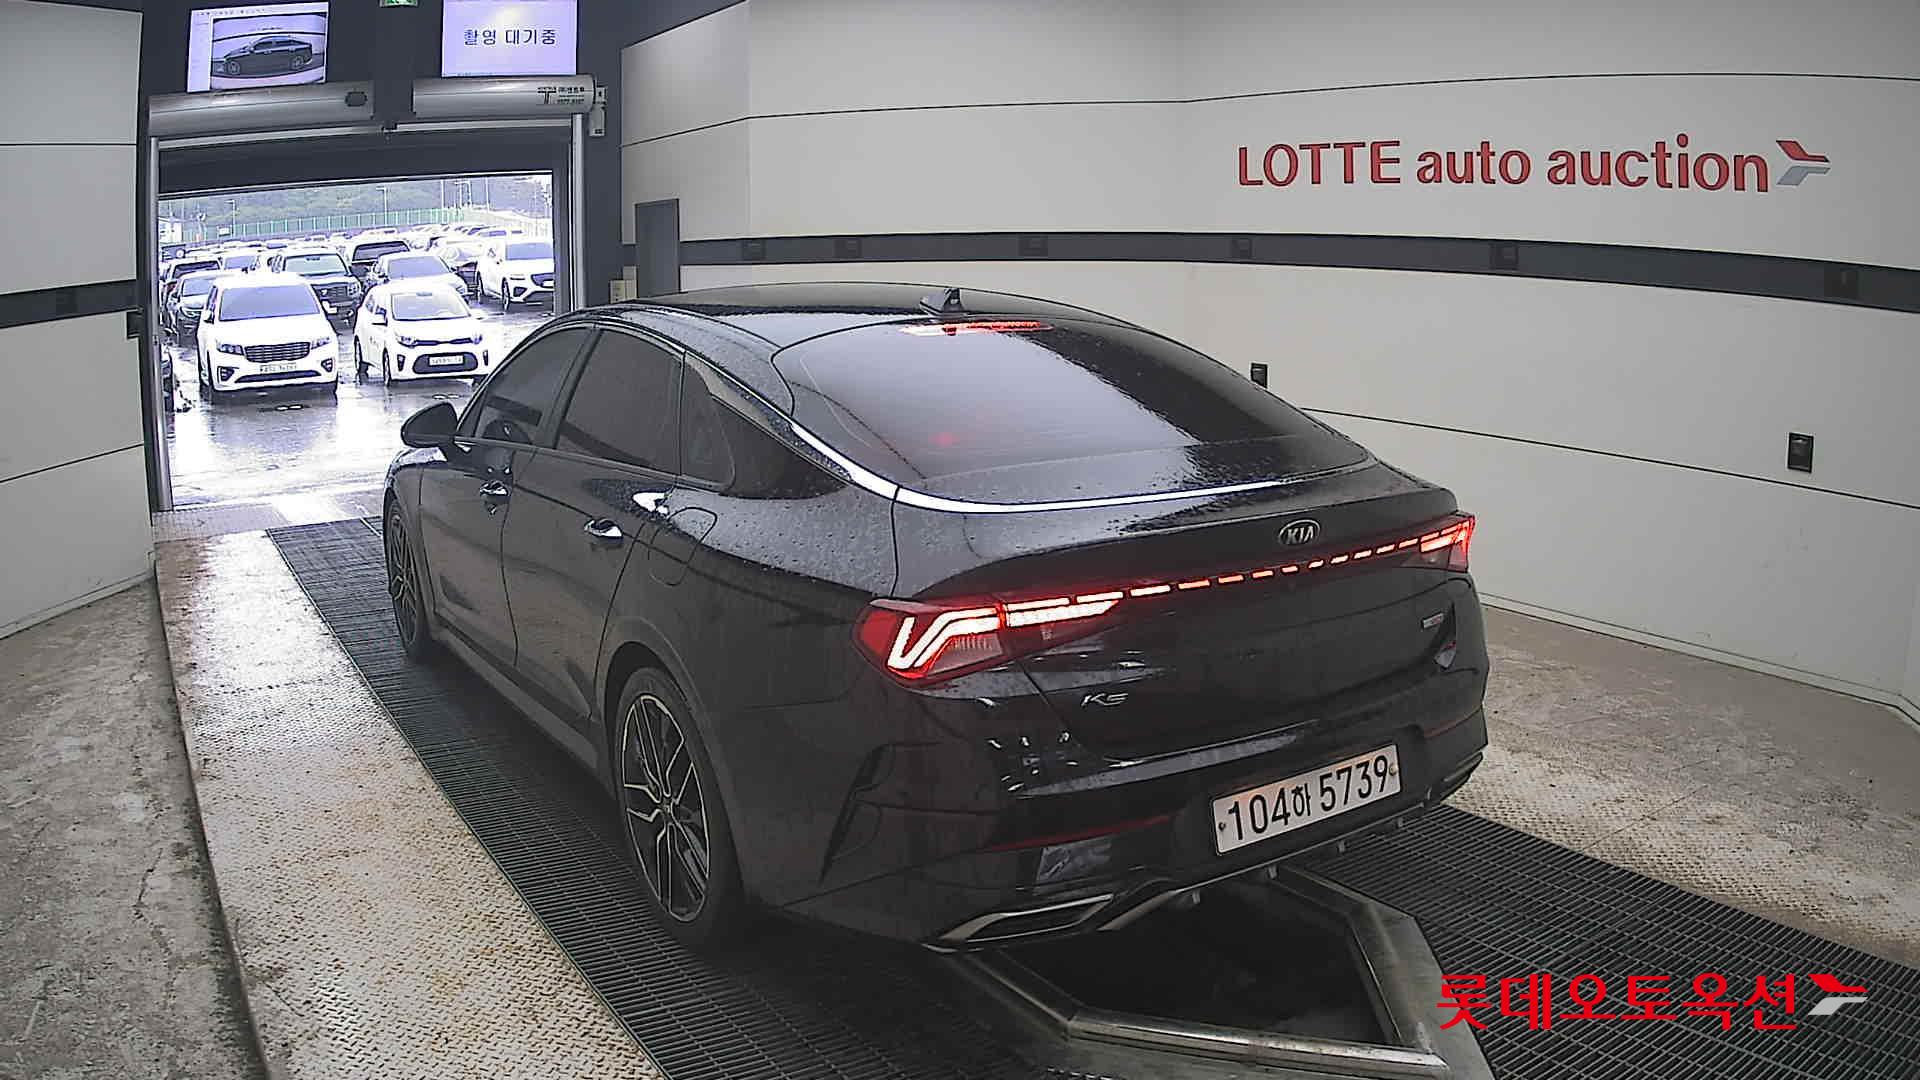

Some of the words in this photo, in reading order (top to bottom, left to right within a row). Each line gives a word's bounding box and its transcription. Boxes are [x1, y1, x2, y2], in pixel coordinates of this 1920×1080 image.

[505, 29, 556, 45] 대기중
[1238, 140, 1401, 187] LOTTE
[1416, 141, 1532, 185] auto
[1546, 133, 1769, 192] auction
[1287, 527, 1315, 545] KIA
[1228, 782, 1311, 840] 104하
[1319, 755, 1389, 812] 5739
